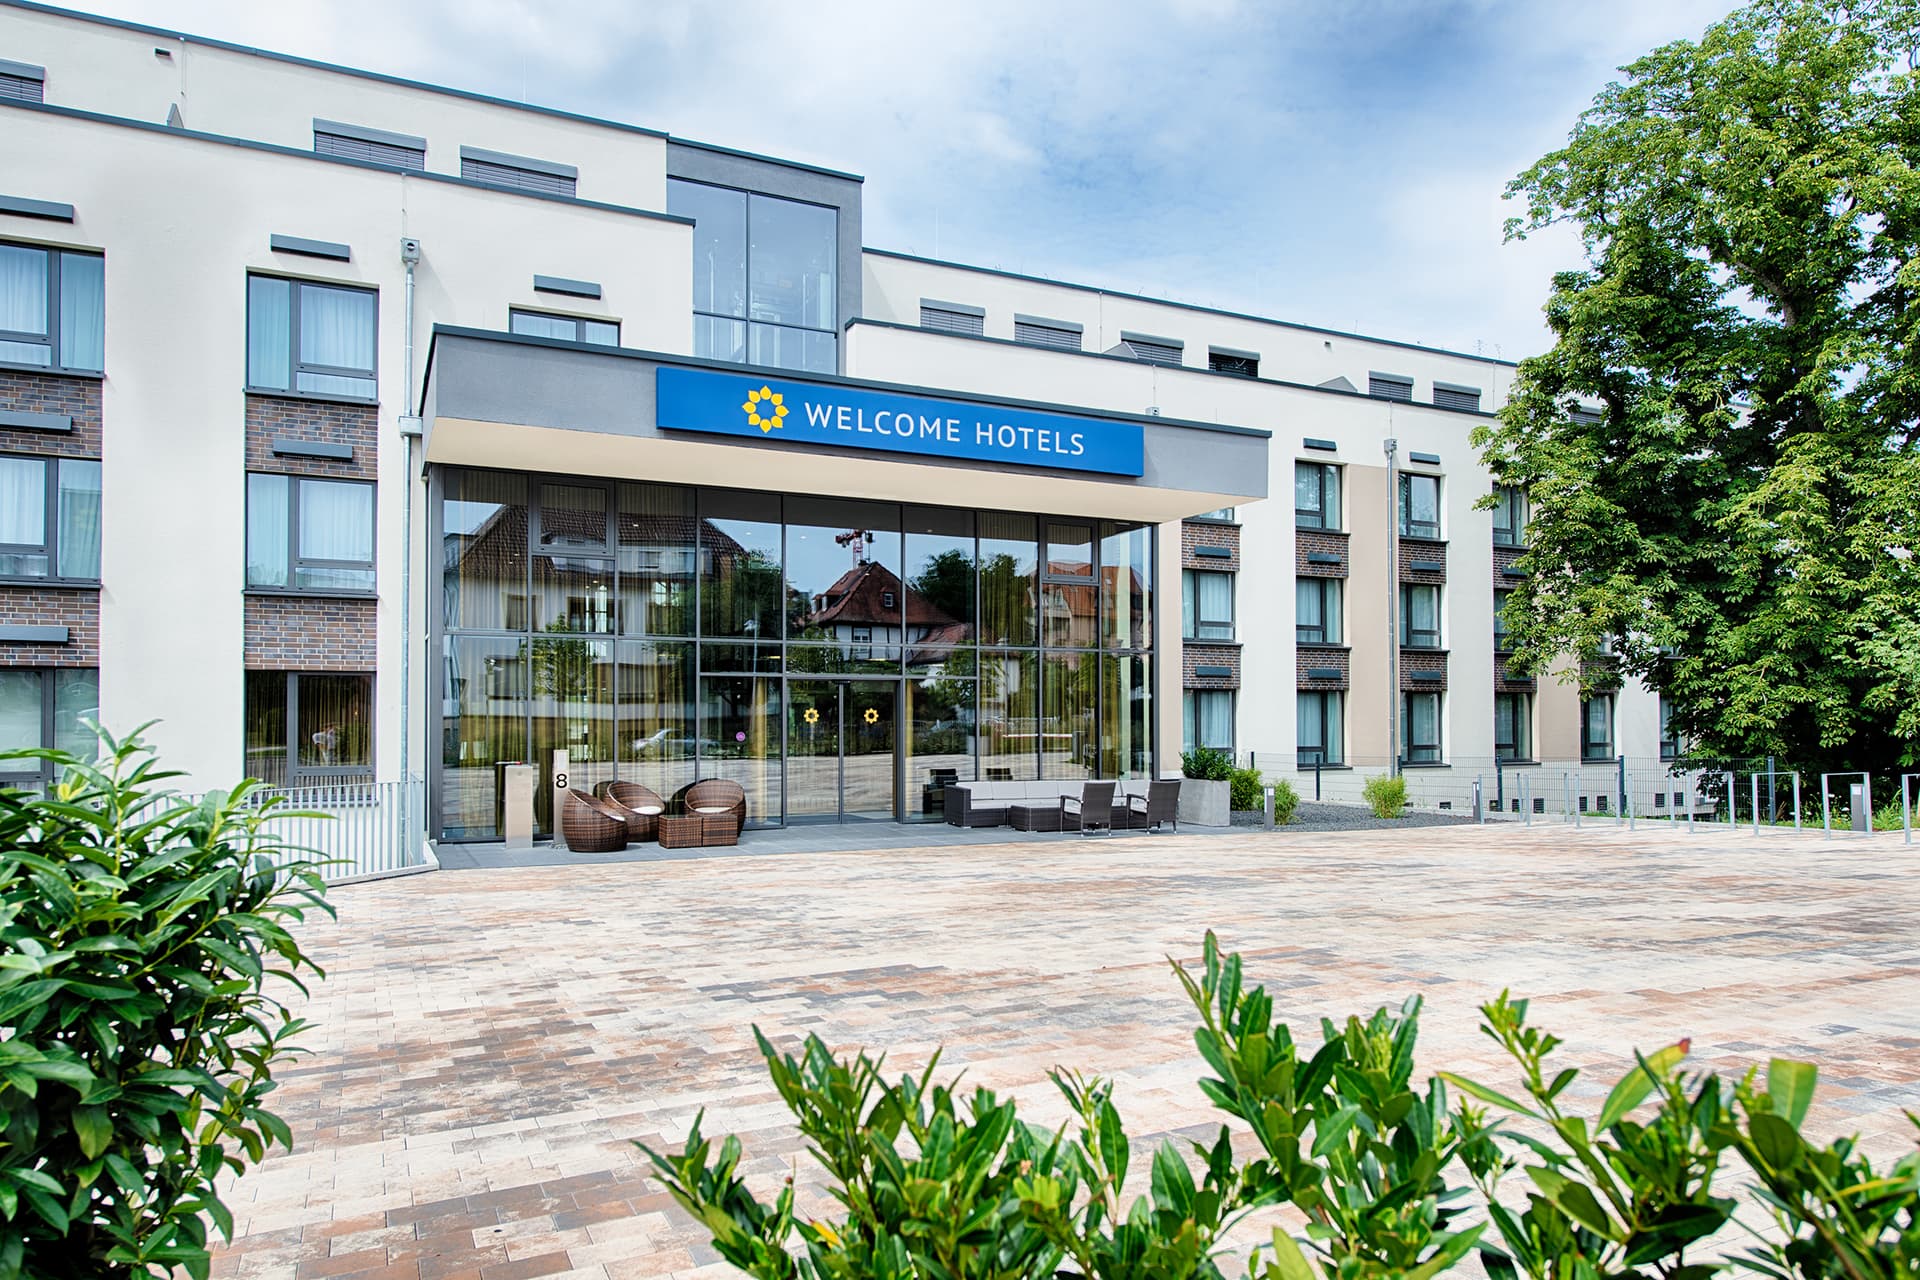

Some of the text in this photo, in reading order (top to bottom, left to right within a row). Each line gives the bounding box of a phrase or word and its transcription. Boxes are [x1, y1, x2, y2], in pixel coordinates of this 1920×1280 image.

[804, 402, 1084, 456] WELCOME HOTELS
[556, 773, 567, 788] 8
